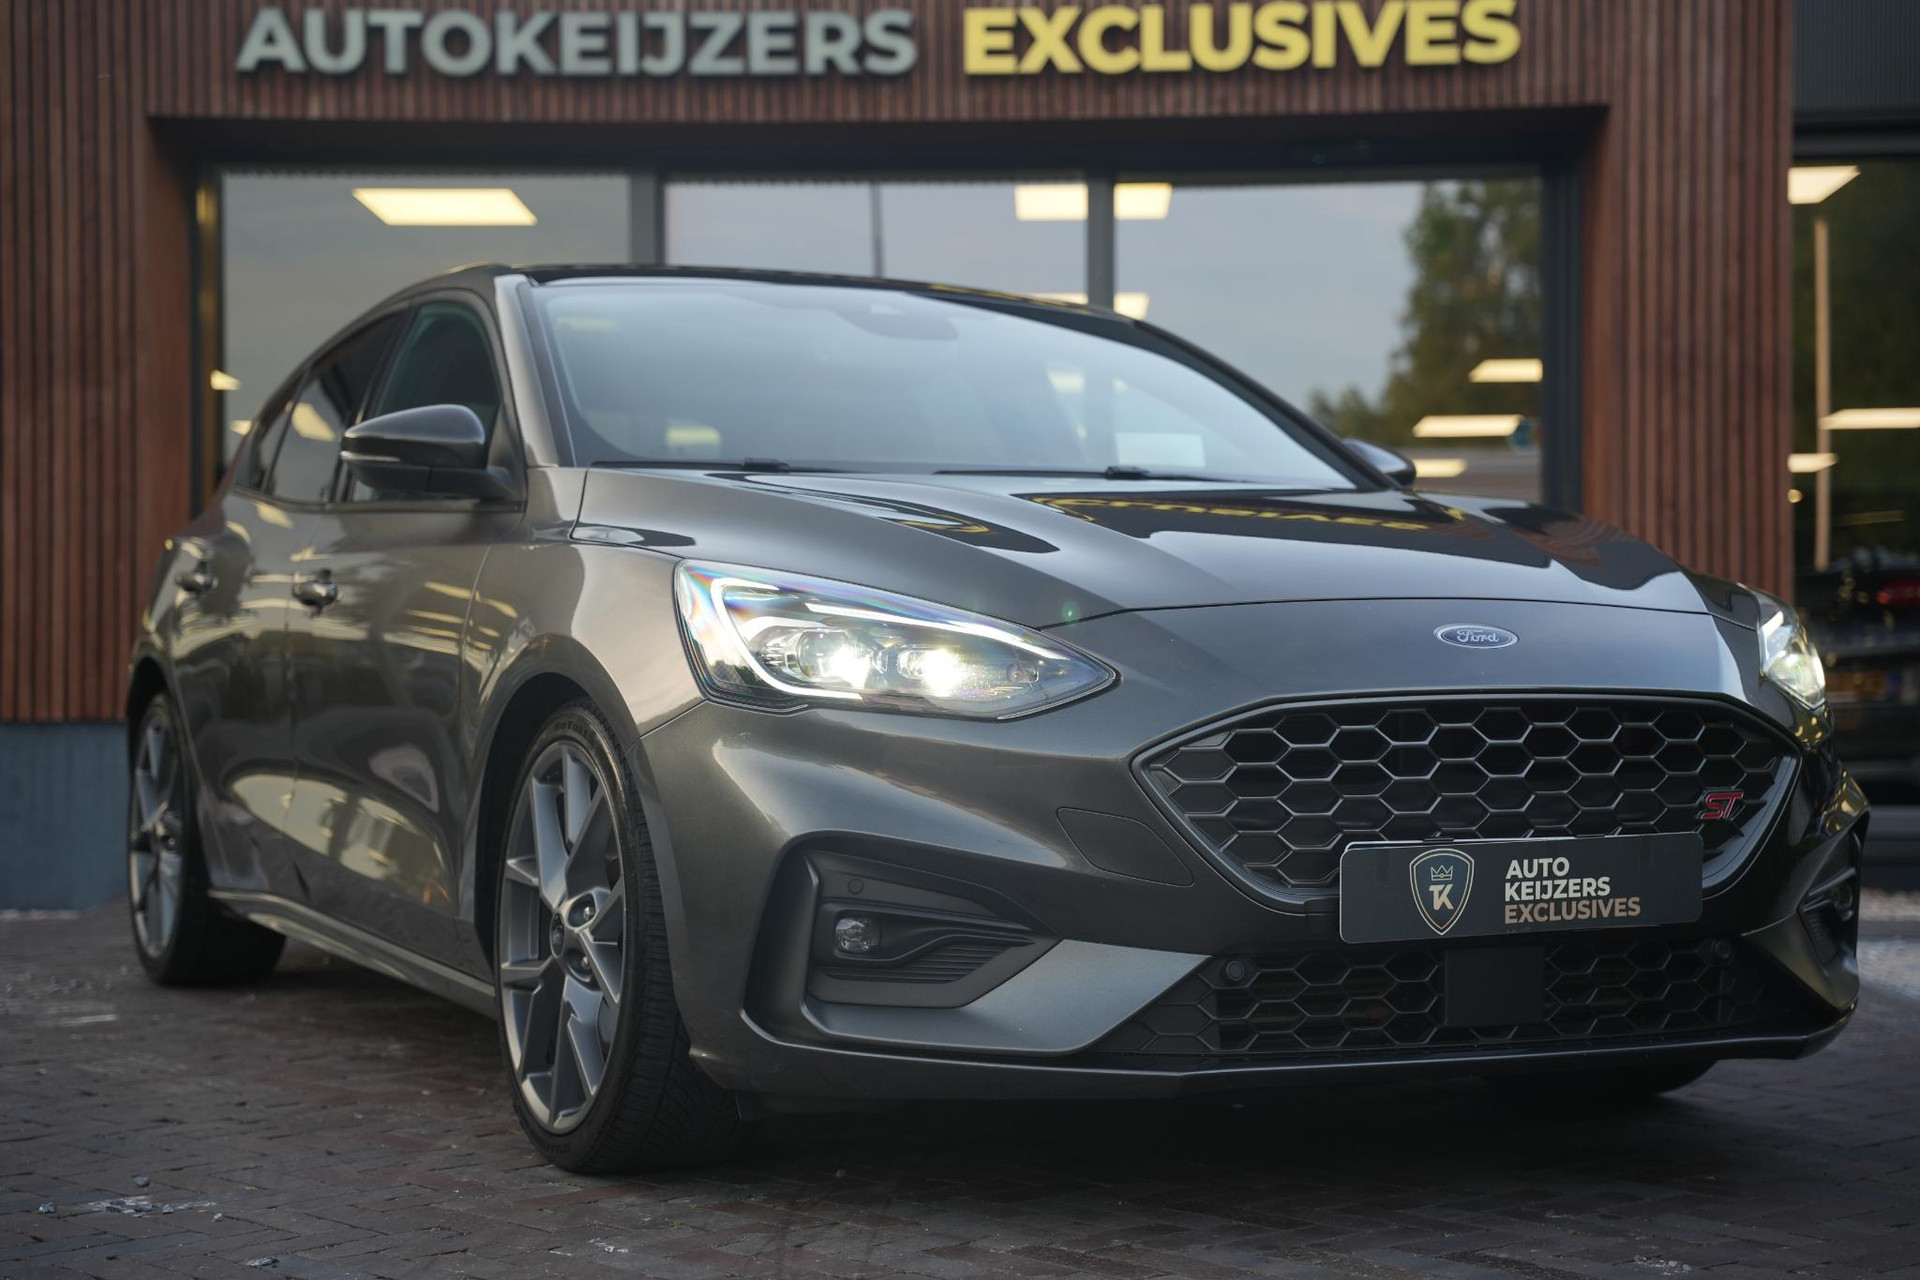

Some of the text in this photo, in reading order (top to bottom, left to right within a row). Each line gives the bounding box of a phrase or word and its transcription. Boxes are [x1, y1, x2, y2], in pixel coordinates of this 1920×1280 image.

[236, 0, 1522, 77] AUTOKEIJZERS EXCLUSIVES
[1456, 629, 1500, 643] Ford
[1700, 792, 1744, 819] ST
[1505, 857, 1570, 879] AUTO
[1505, 876, 1611, 901] KEIJZERS
[1504, 896, 1642, 925] EXCLUSIVES
